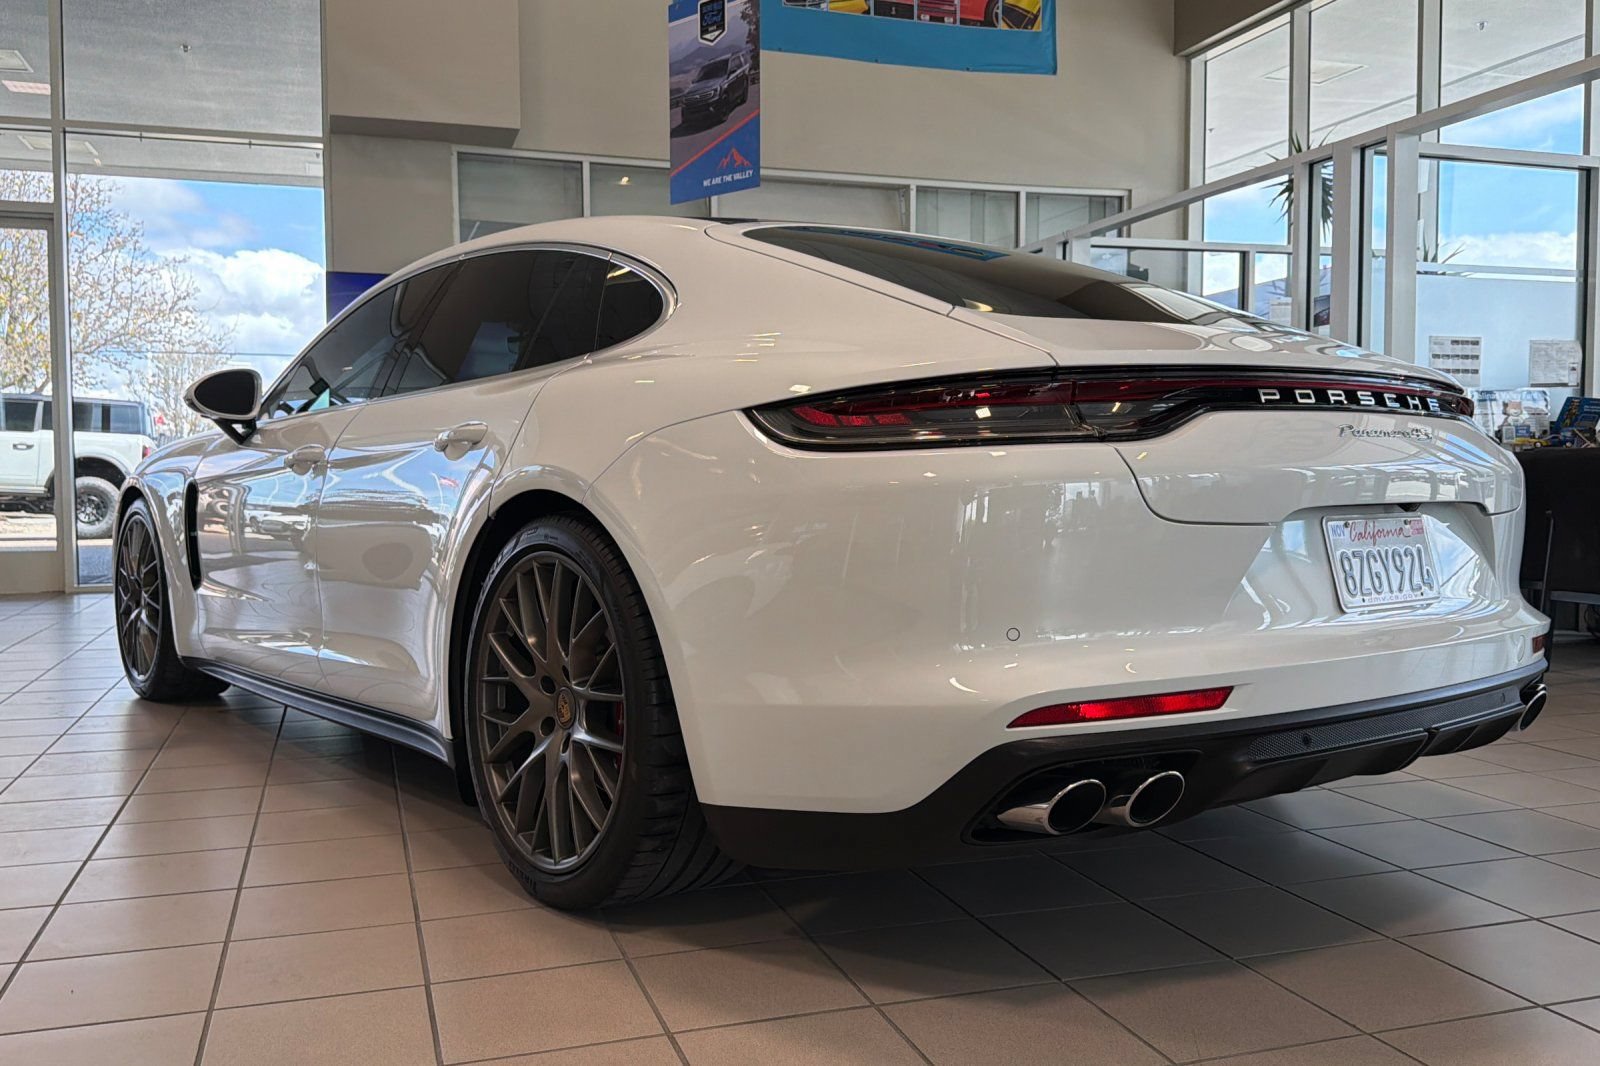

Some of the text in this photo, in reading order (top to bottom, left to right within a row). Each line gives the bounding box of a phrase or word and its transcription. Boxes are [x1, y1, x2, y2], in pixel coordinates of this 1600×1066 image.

[703, 169, 754, 187] WE ARE THE VALLEY
[1258, 388, 1441, 412] PORSCHE
[1349, 520, 1411, 547] California
[1339, 545, 1435, 599] 8ZGY924
[1367, 593, 1418, 604] dmv.ca.gov
